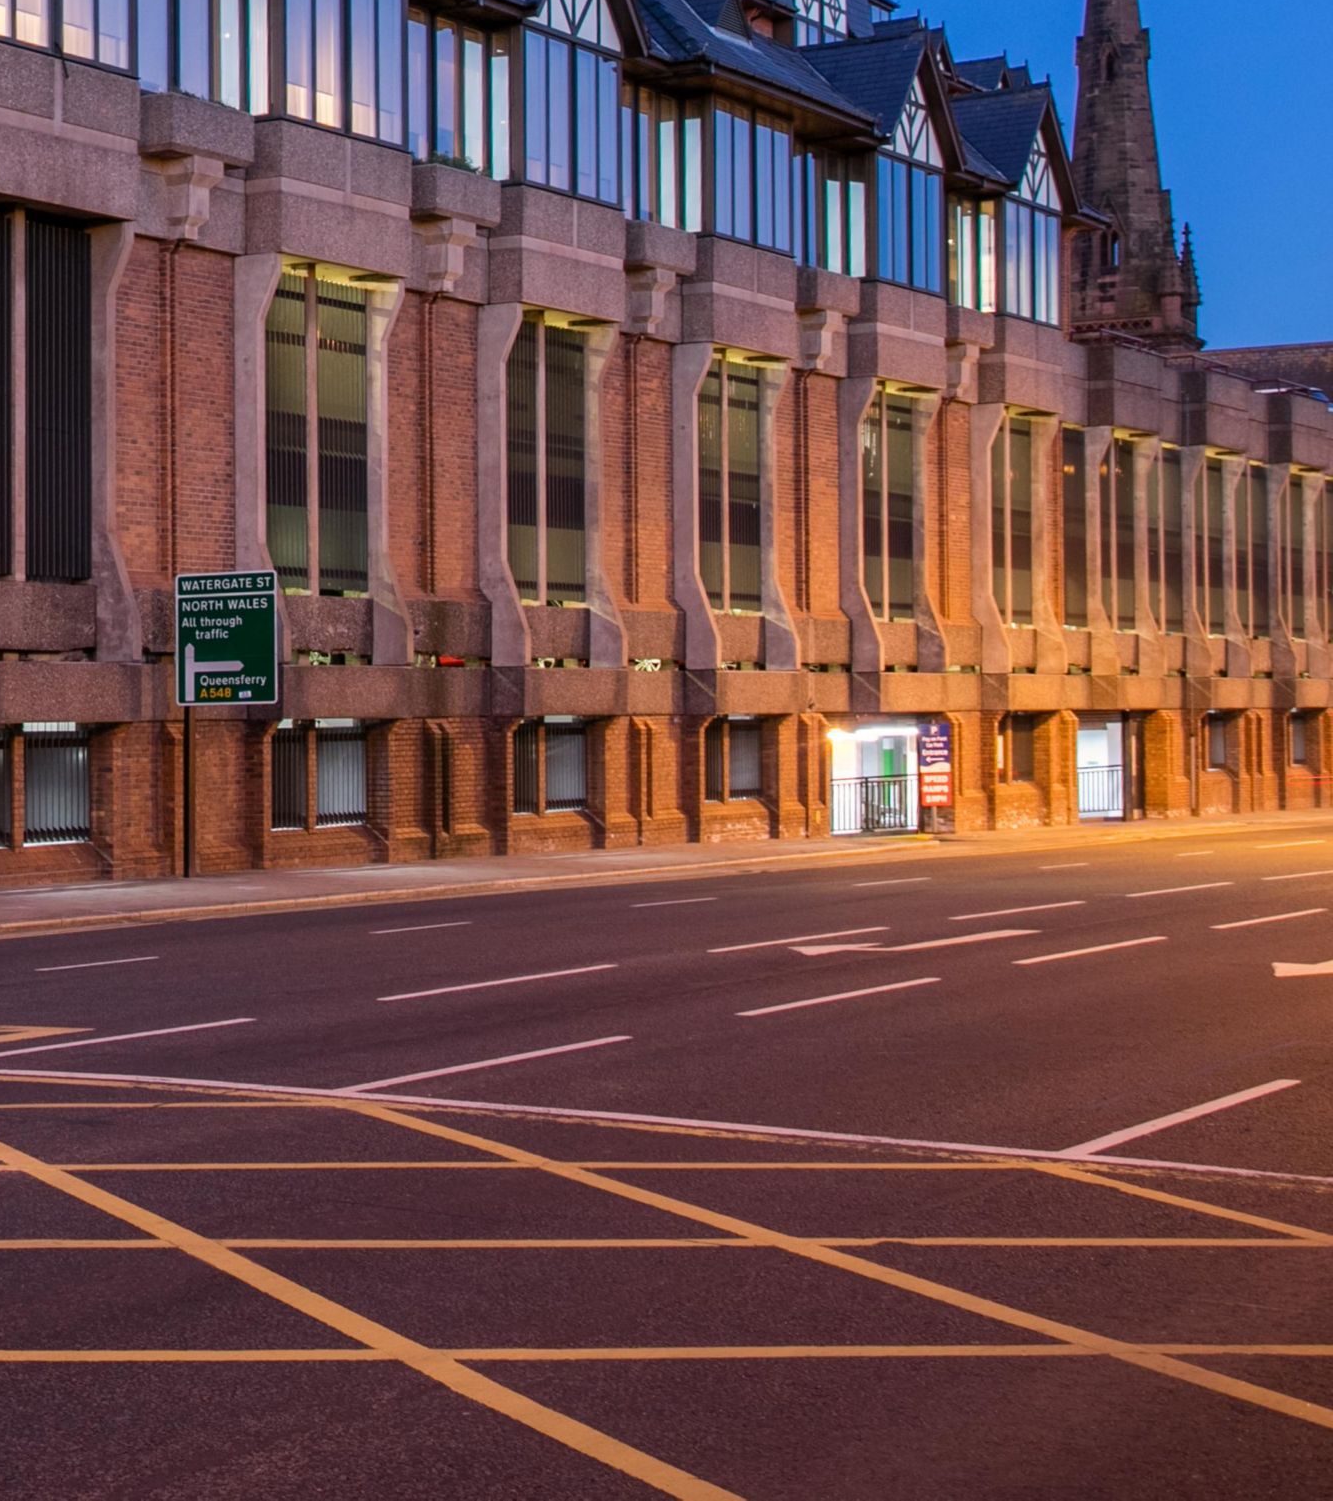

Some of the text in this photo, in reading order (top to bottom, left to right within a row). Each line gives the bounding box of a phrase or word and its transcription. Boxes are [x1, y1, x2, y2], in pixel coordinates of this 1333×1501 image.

[181, 576, 271, 591] WATERGATE ST
[181, 597, 268, 612] NORTH WALES
[181, 615, 243, 628] All through
[195, 628, 230, 640] traffic
[199, 674, 267, 688] Queensferry
[930, 726, 938, 735] P
[924, 775, 949, 783] SPEED
